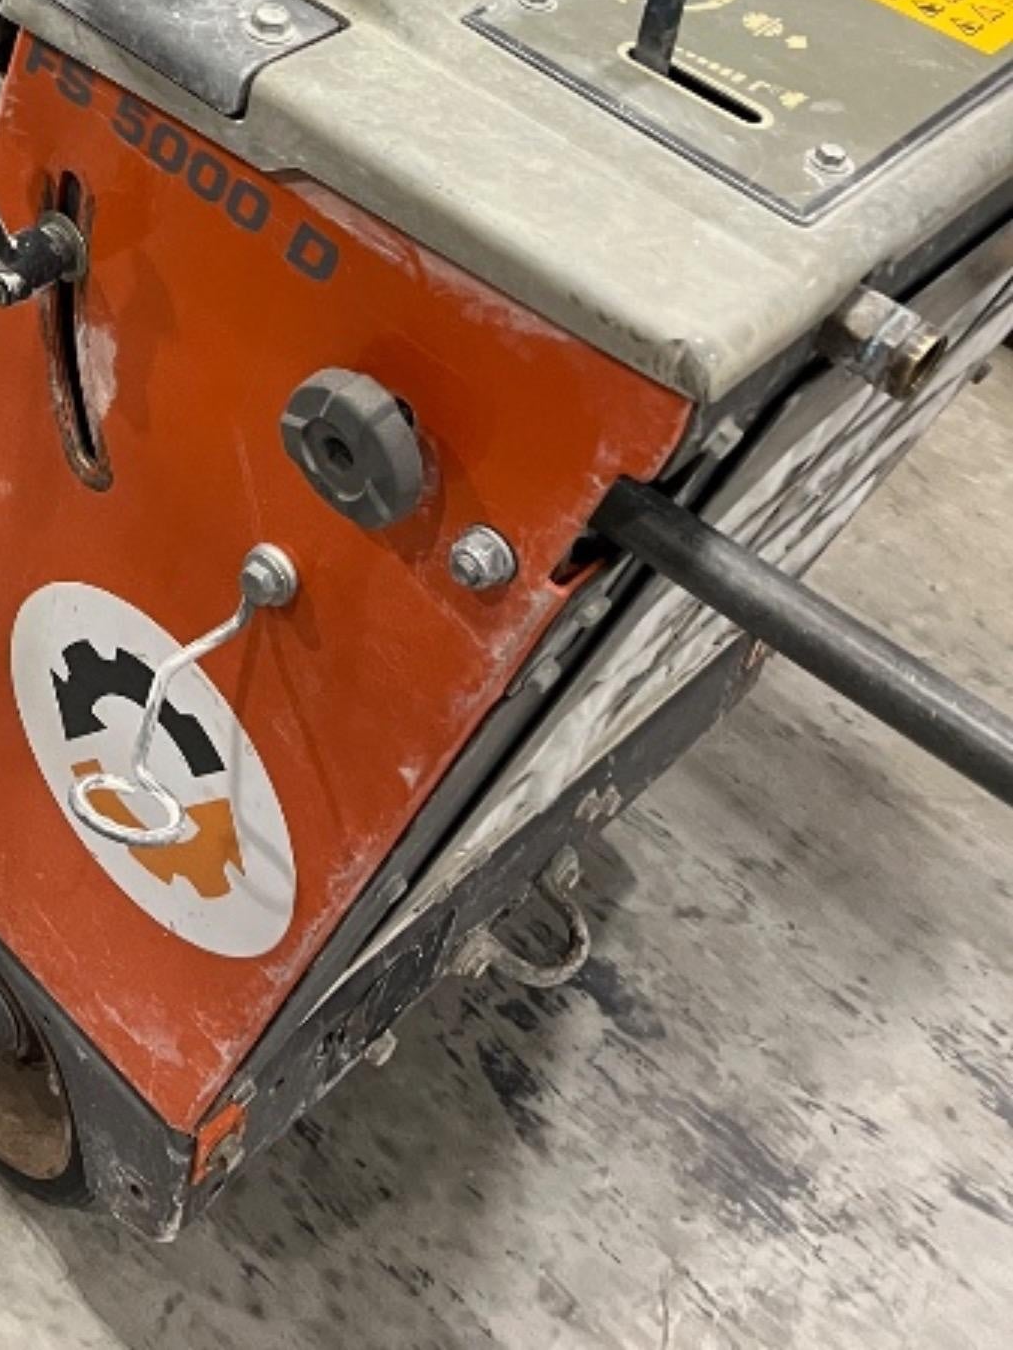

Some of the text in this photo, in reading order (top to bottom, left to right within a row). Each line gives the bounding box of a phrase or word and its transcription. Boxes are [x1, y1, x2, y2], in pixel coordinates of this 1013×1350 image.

[24, 46, 341, 283] FS 5000 D
